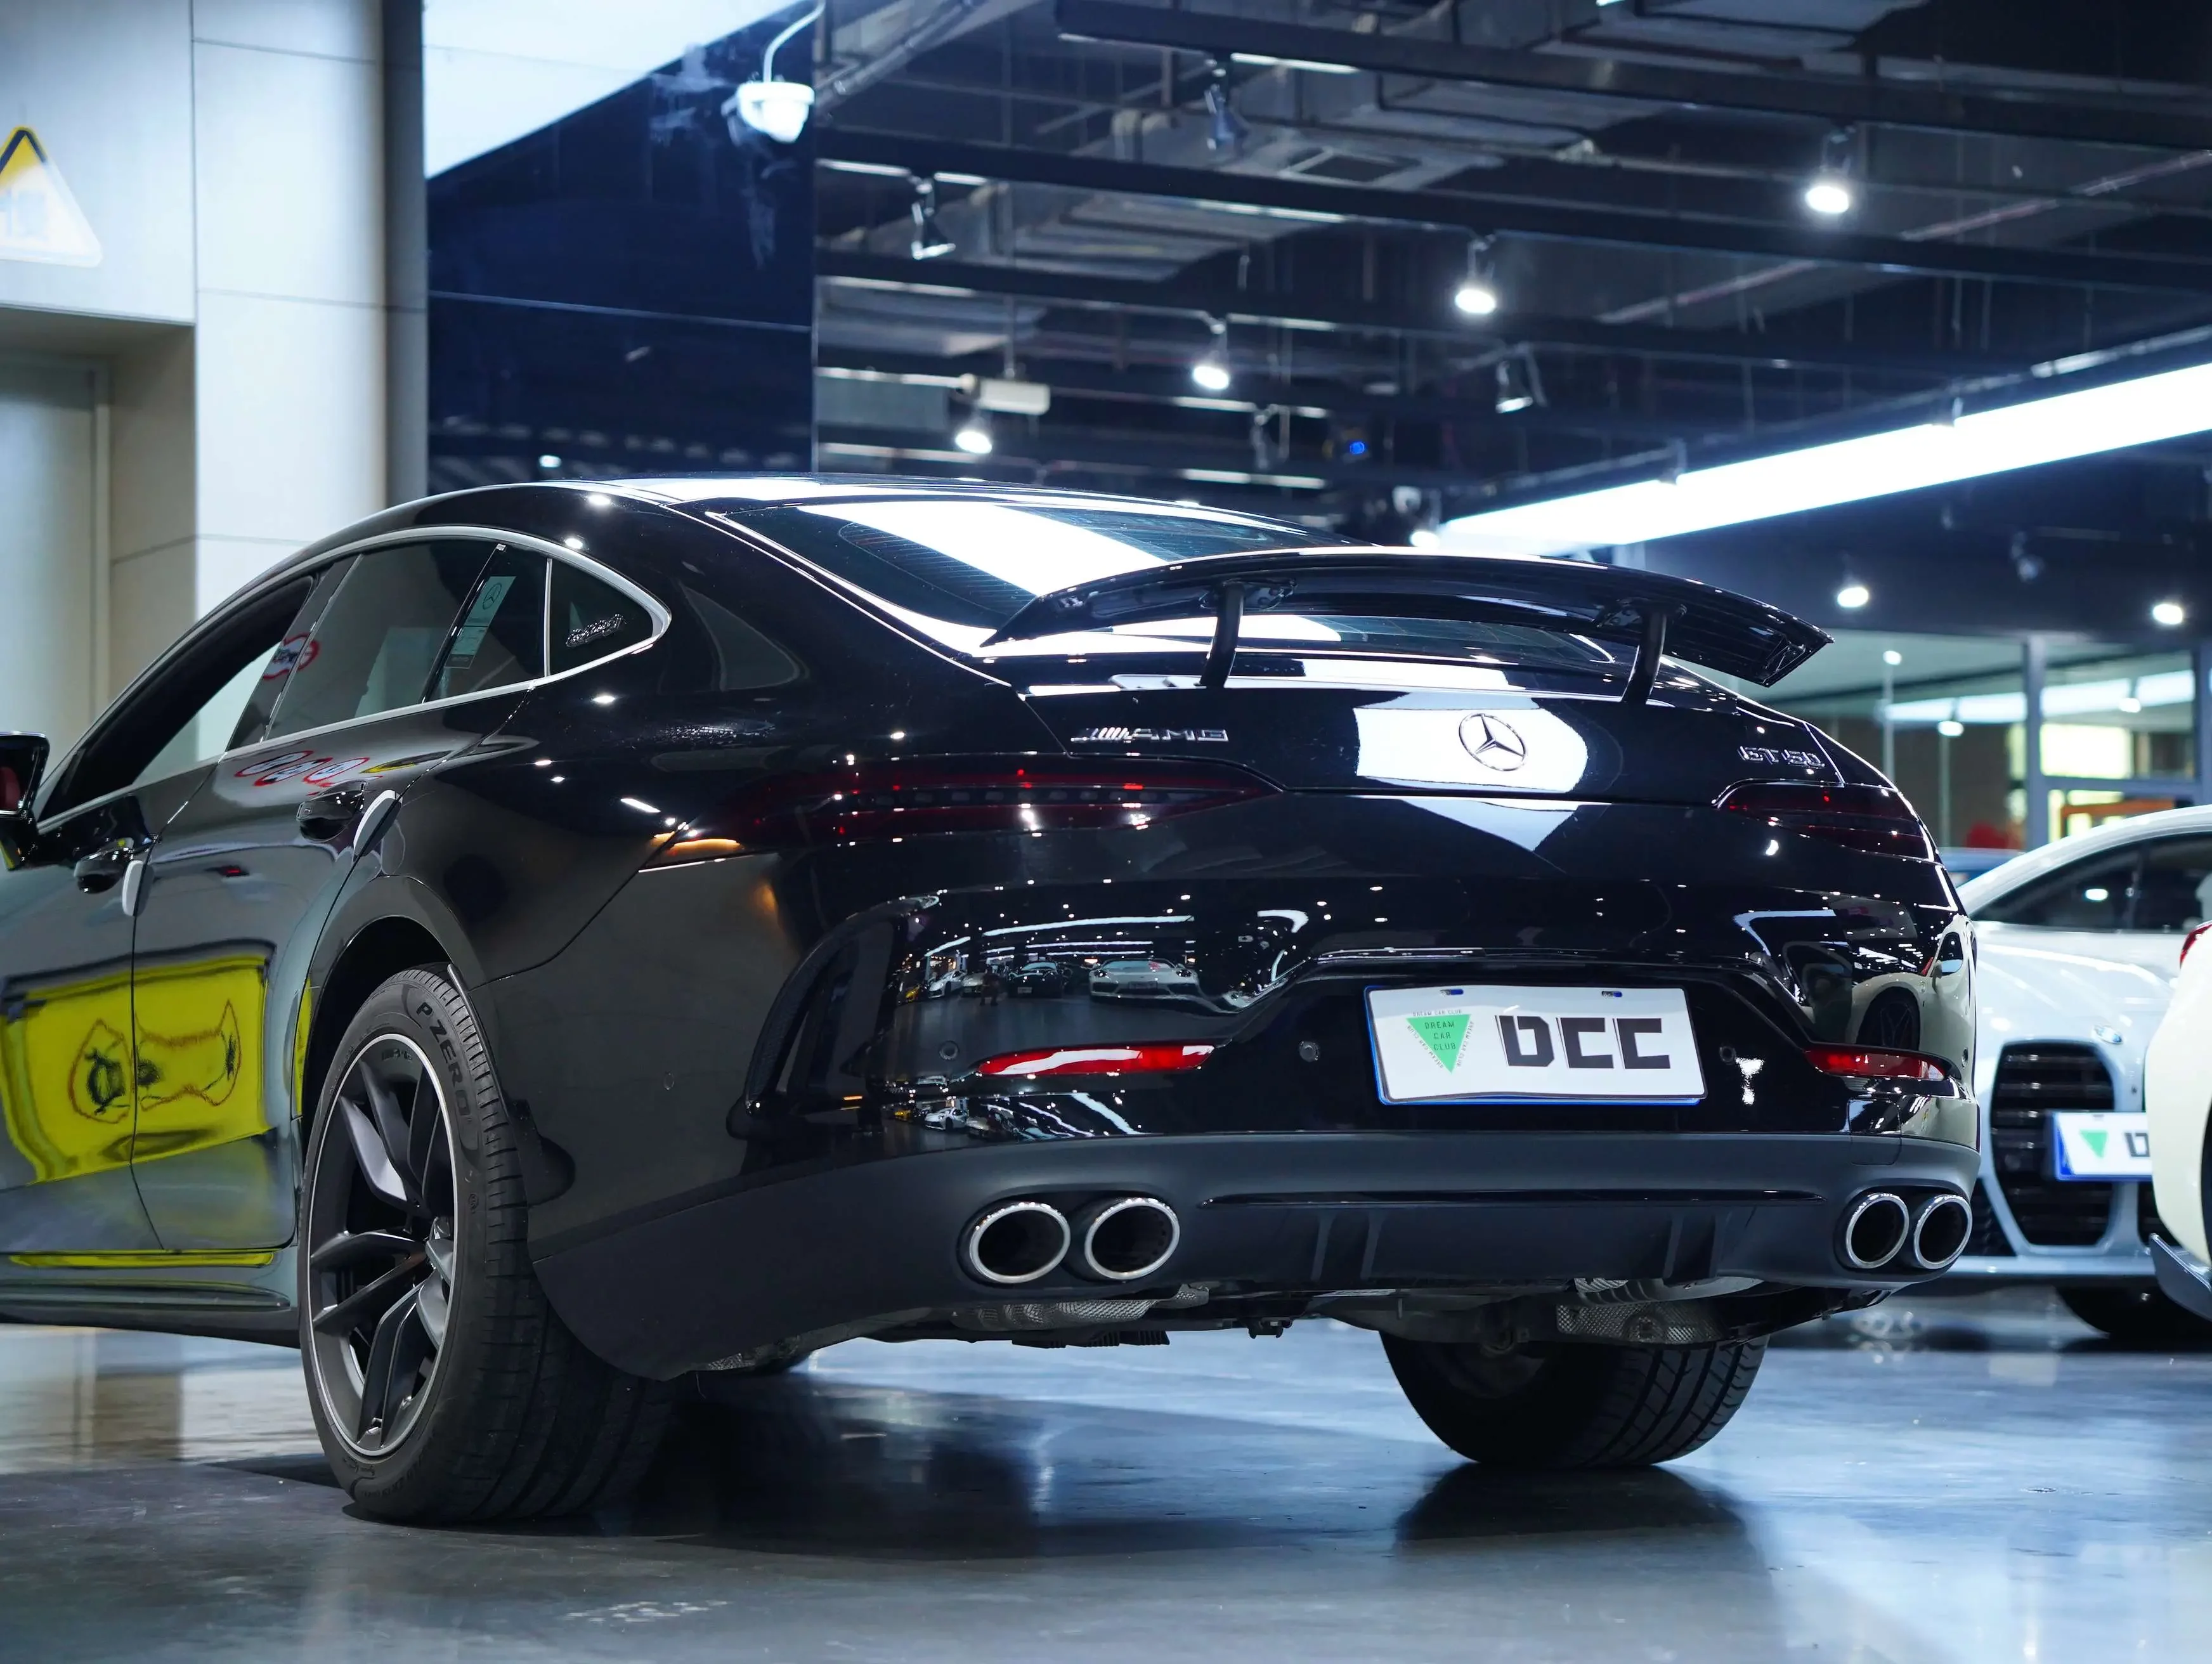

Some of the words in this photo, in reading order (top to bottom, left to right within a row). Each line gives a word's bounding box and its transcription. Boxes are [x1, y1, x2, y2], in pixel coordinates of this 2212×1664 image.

[1131, 728, 1229, 742] AMG
[1738, 746, 1779, 765] GT
[1781, 749, 1825, 769] 50
[416, 1001, 434, 1017] P
[430, 1019, 471, 1116] ZERO
[1495, 1015, 1671, 1069] DCC
